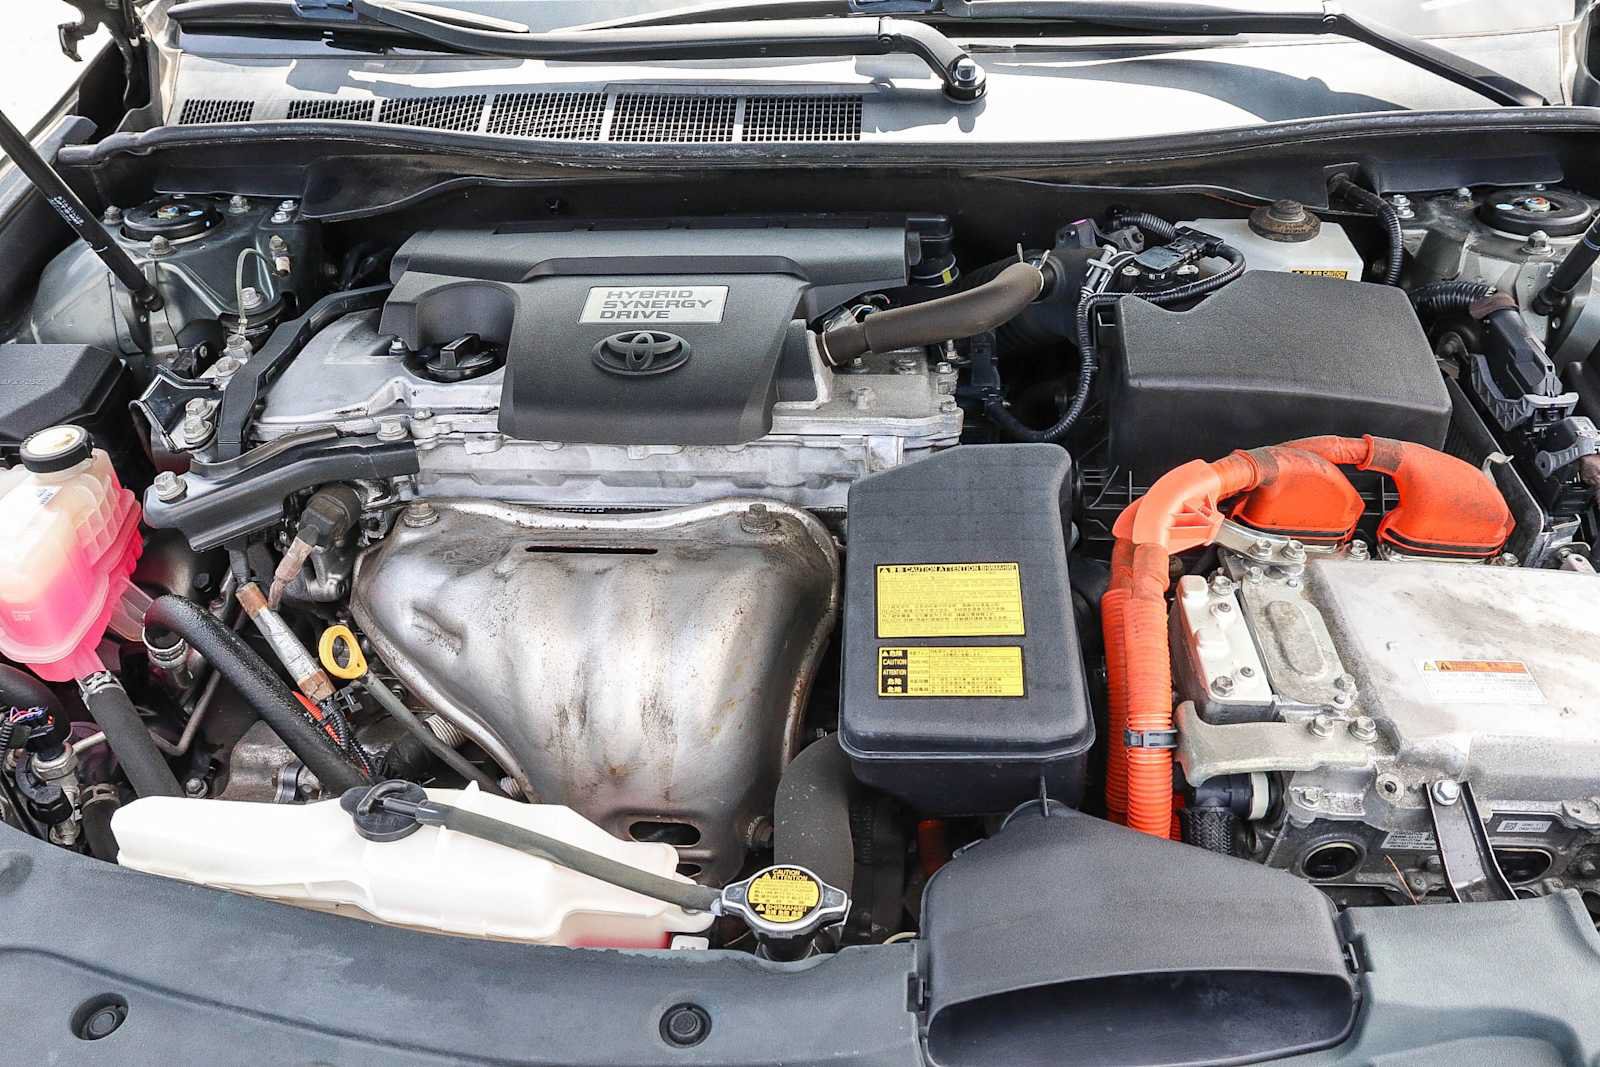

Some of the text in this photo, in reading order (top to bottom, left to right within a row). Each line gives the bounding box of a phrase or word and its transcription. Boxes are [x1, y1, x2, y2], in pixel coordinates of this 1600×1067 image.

[606, 290, 694, 299] HYBRID
[602, 299, 713, 309] SYNERGY
[599, 310, 671, 320] DRIVE
[883, 658, 907, 666] CAUTION
[882, 668, 907, 676] ATTENTION
